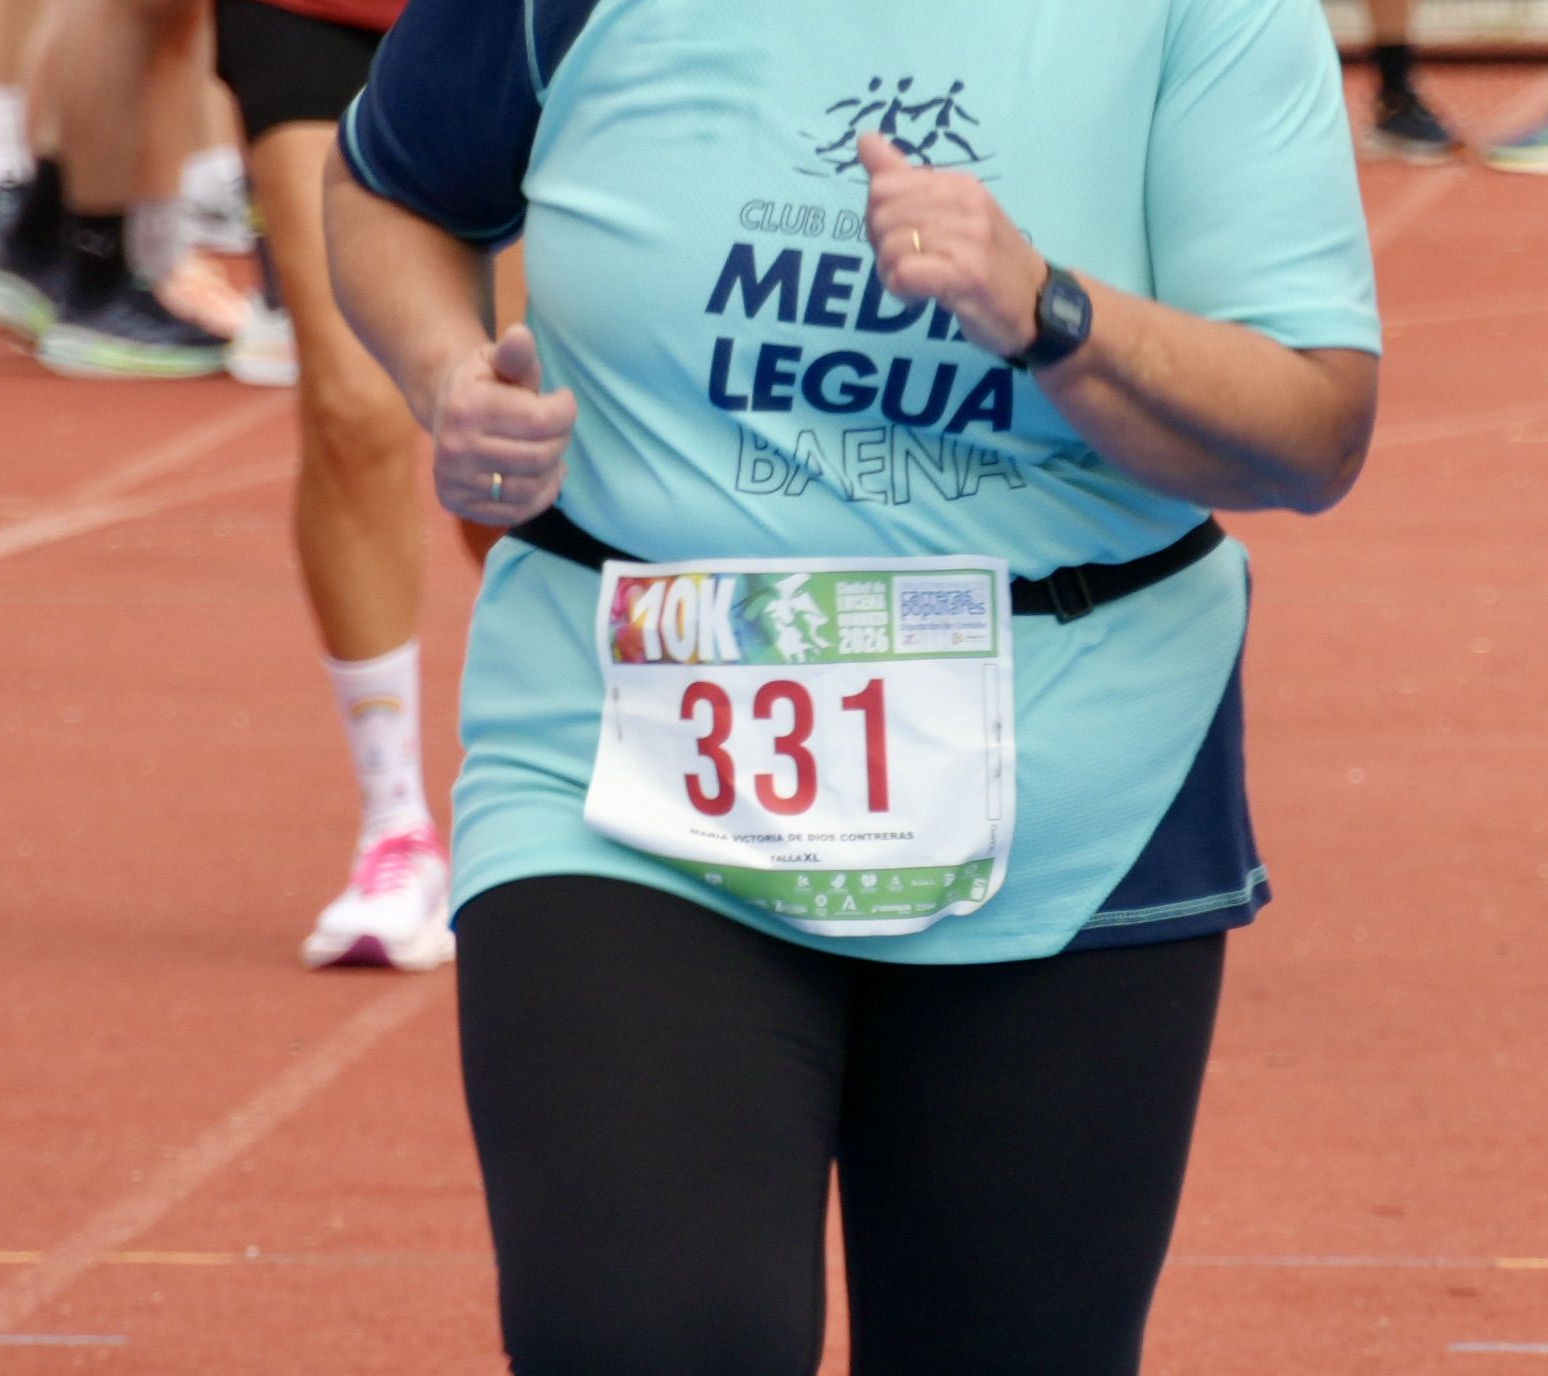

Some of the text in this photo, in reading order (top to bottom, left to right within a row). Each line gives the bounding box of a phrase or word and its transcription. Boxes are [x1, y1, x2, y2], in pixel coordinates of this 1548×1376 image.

[739, 199, 827, 239] CLUB
[704, 242, 970, 344] MEDI
[708, 337, 1014, 434] LEGUA
[735, 423, 1027, 506] BAENA
[631, 576, 741, 662] 10K
[680, 678, 890, 817] 331
[732, 832, 784, 844] VICTORIA
[787, 832, 803, 843] DE
[807, 832, 837, 843] DIOS
[839, 830, 915, 843] CONTRERAS
[803, 852, 821, 863] XL
